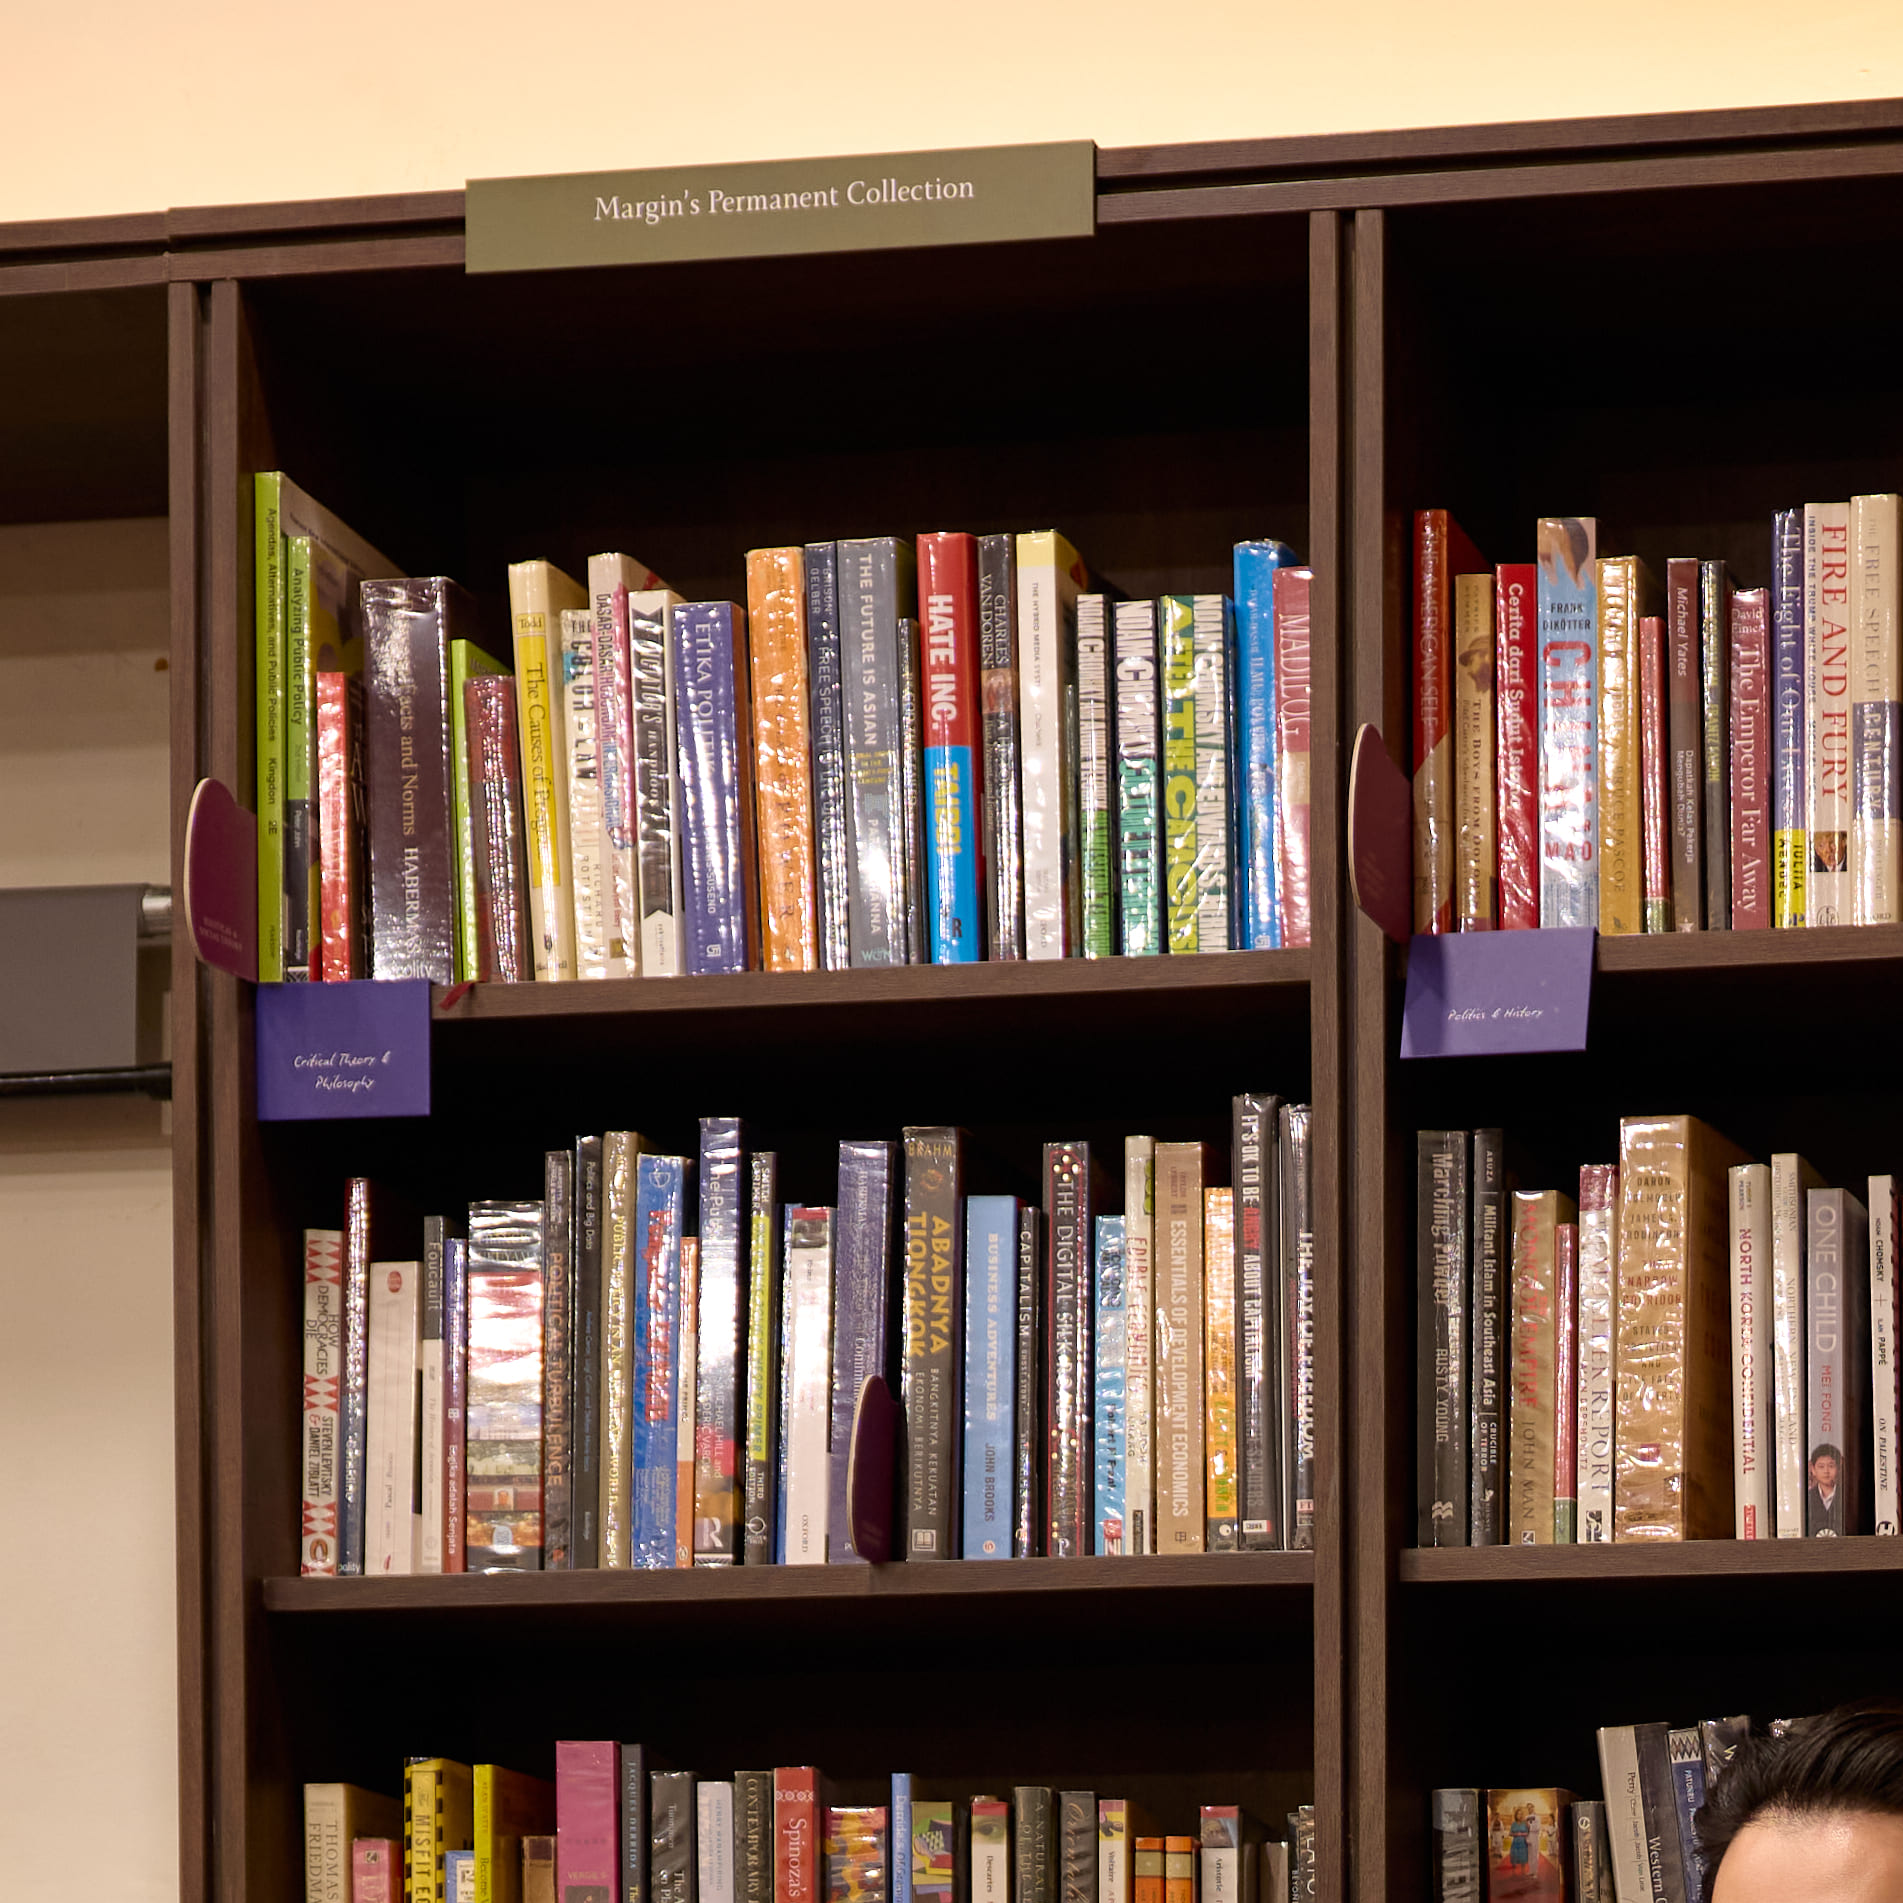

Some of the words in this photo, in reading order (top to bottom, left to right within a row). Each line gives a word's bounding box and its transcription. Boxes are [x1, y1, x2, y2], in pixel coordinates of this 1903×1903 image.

[594, 190, 700, 225] Margin's
[708, 185, 839, 214] Permanent
[847, 178, 973, 203] Collection
[859, 553, 872, 590] THE
[1822, 524, 1846, 605] FIRE
[291, 568, 304, 633] Analyzing
[861, 595, 875, 664] FUTURE
[928, 594, 955, 665] HATE
[1823, 617, 1847, 696] AND
[292, 637, 305, 680] Public
[863, 669, 876, 686] IS
[1739, 644, 1759, 692] The
[291, 684, 305, 724] Policy
[400, 685, 417, 730] Facts
[864, 691, 877, 745] ASIAN
[931, 674, 957, 730] INC.
[401, 735, 417, 769] and
[1735, 699, 1761, 802] Emperor
[1823, 711, 1848, 803] FURY
[402, 775, 419, 835] Norms
[1742, 809, 1761, 847] Far
[403, 847, 421, 954] HABERMAS
[1737, 853, 1761, 912] Away
[1448, 1008, 1485, 1020] Politics
[1504, 1006, 1543, 1018] History
[294, 1052, 336, 1068] Critical
[339, 1052, 376, 1066] Theory
[315, 1075, 374, 1092] Philosophy
[1815, 1204, 1836, 1264] ONE
[987, 1232, 998, 1313] BUSINESS
[306, 1318, 318, 1339] DIE
[317, 1285, 329, 1375] DEMOCRACIES
[328, 1314, 339, 1348] HOW
[1815, 1272, 1838, 1353] CHILD
[986, 1317, 998, 1421] ADVENTURES
[1821, 1365, 1831, 1388] MEI
[1821, 1393, 1832, 1432] FONG
[984, 1442, 995, 1471] JOHN
[984, 1476, 995, 1522] BROOKS
[415, 1814, 430, 1877] MISFIT
[785, 1818, 805, 1897] Spinoza's
[1648, 1836, 1665, 1893] Western
